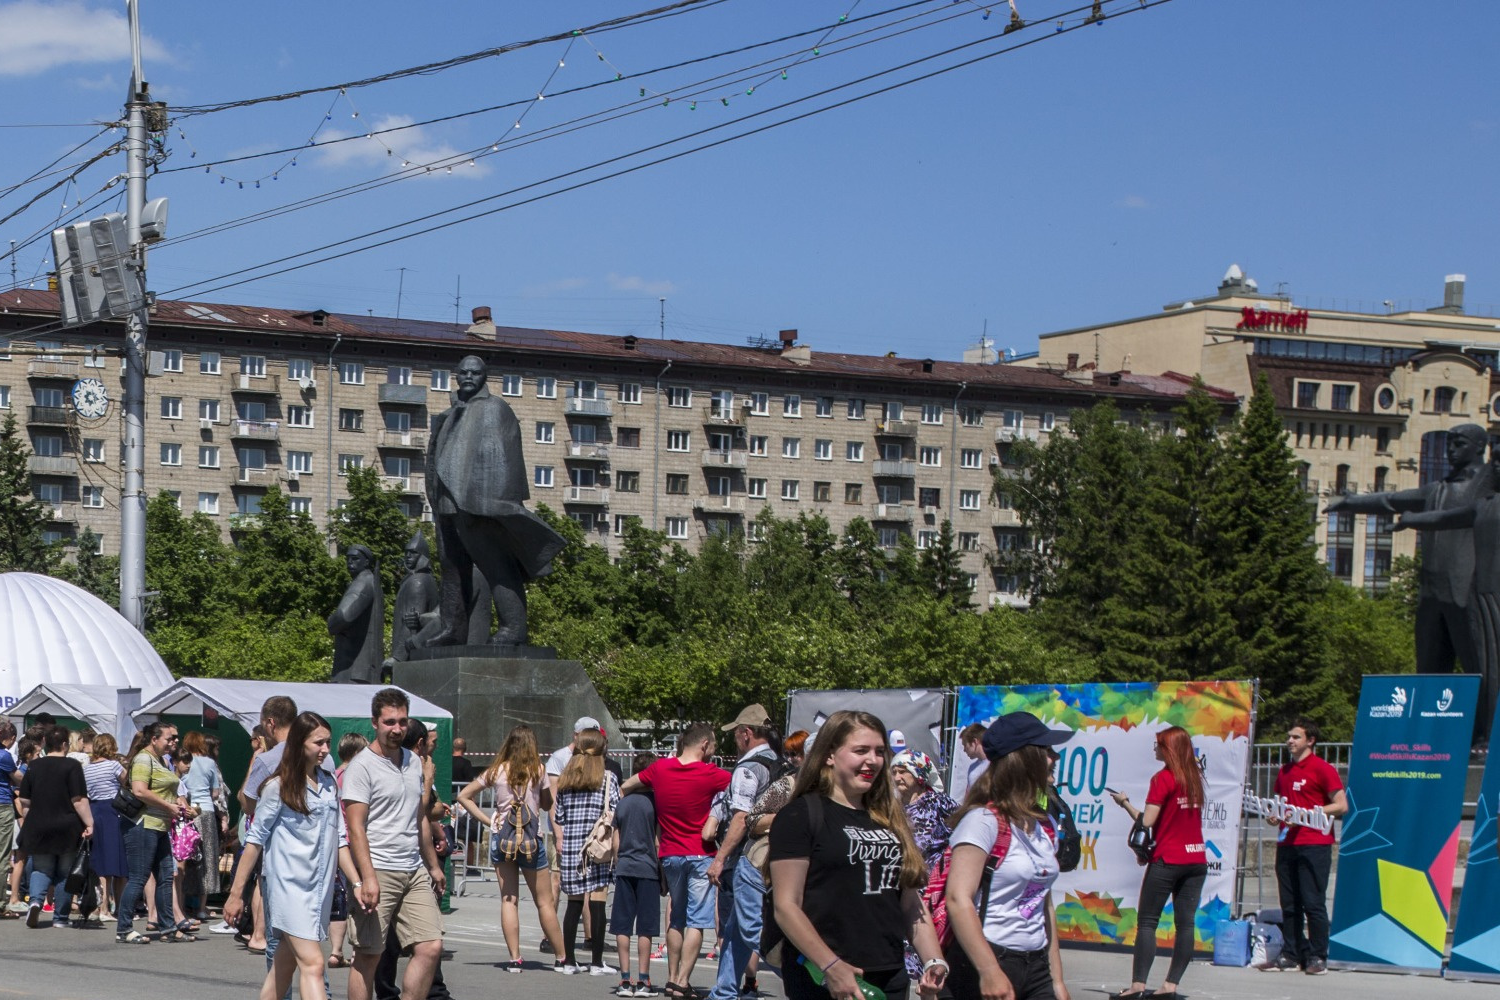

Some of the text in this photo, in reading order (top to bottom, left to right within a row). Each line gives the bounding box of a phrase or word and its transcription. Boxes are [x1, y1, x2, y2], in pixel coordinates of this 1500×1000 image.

[1058, 745, 1109, 797] 100
[1372, 771, 1442, 779] worldskills2019.com
[1072, 800, 1104, 824] НЕЙ
[1242, 788, 1335, 836] #volfamily
